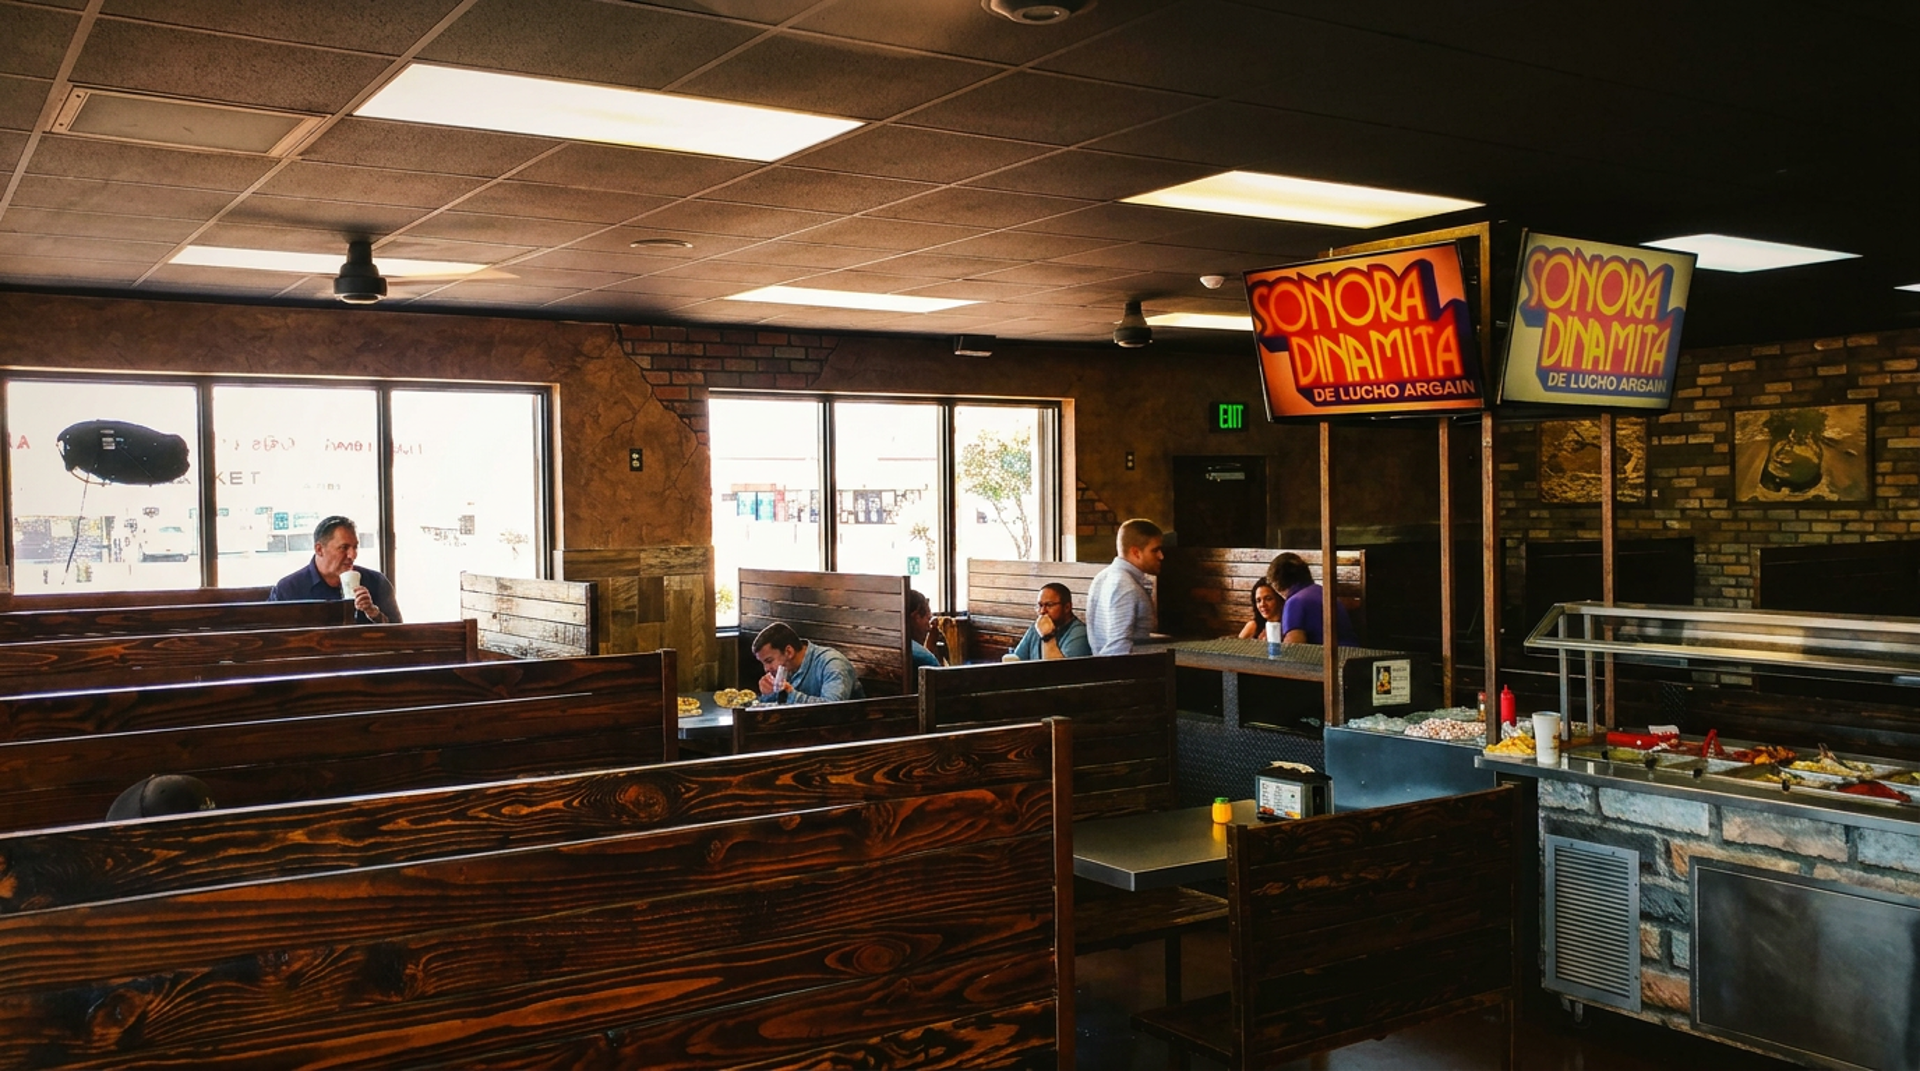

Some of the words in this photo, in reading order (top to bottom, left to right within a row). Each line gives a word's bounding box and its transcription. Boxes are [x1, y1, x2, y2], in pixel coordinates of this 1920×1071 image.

[1253, 268, 1426, 337] SONORA
[1529, 252, 1665, 320] SONORA
[1291, 325, 1464, 386] DINAMITA
[1541, 311, 1671, 376] DINAMITA
[1313, 387, 1336, 402] DE
[1339, 383, 1400, 400] LUCHO
[1404, 379, 1476, 397] ARGAIN
[1547, 372, 1567, 388] DE
[1570, 373, 1617, 390] LUCHO
[1619, 377, 1667, 393] ARGAIN
[214, 471, 261, 485] KET
